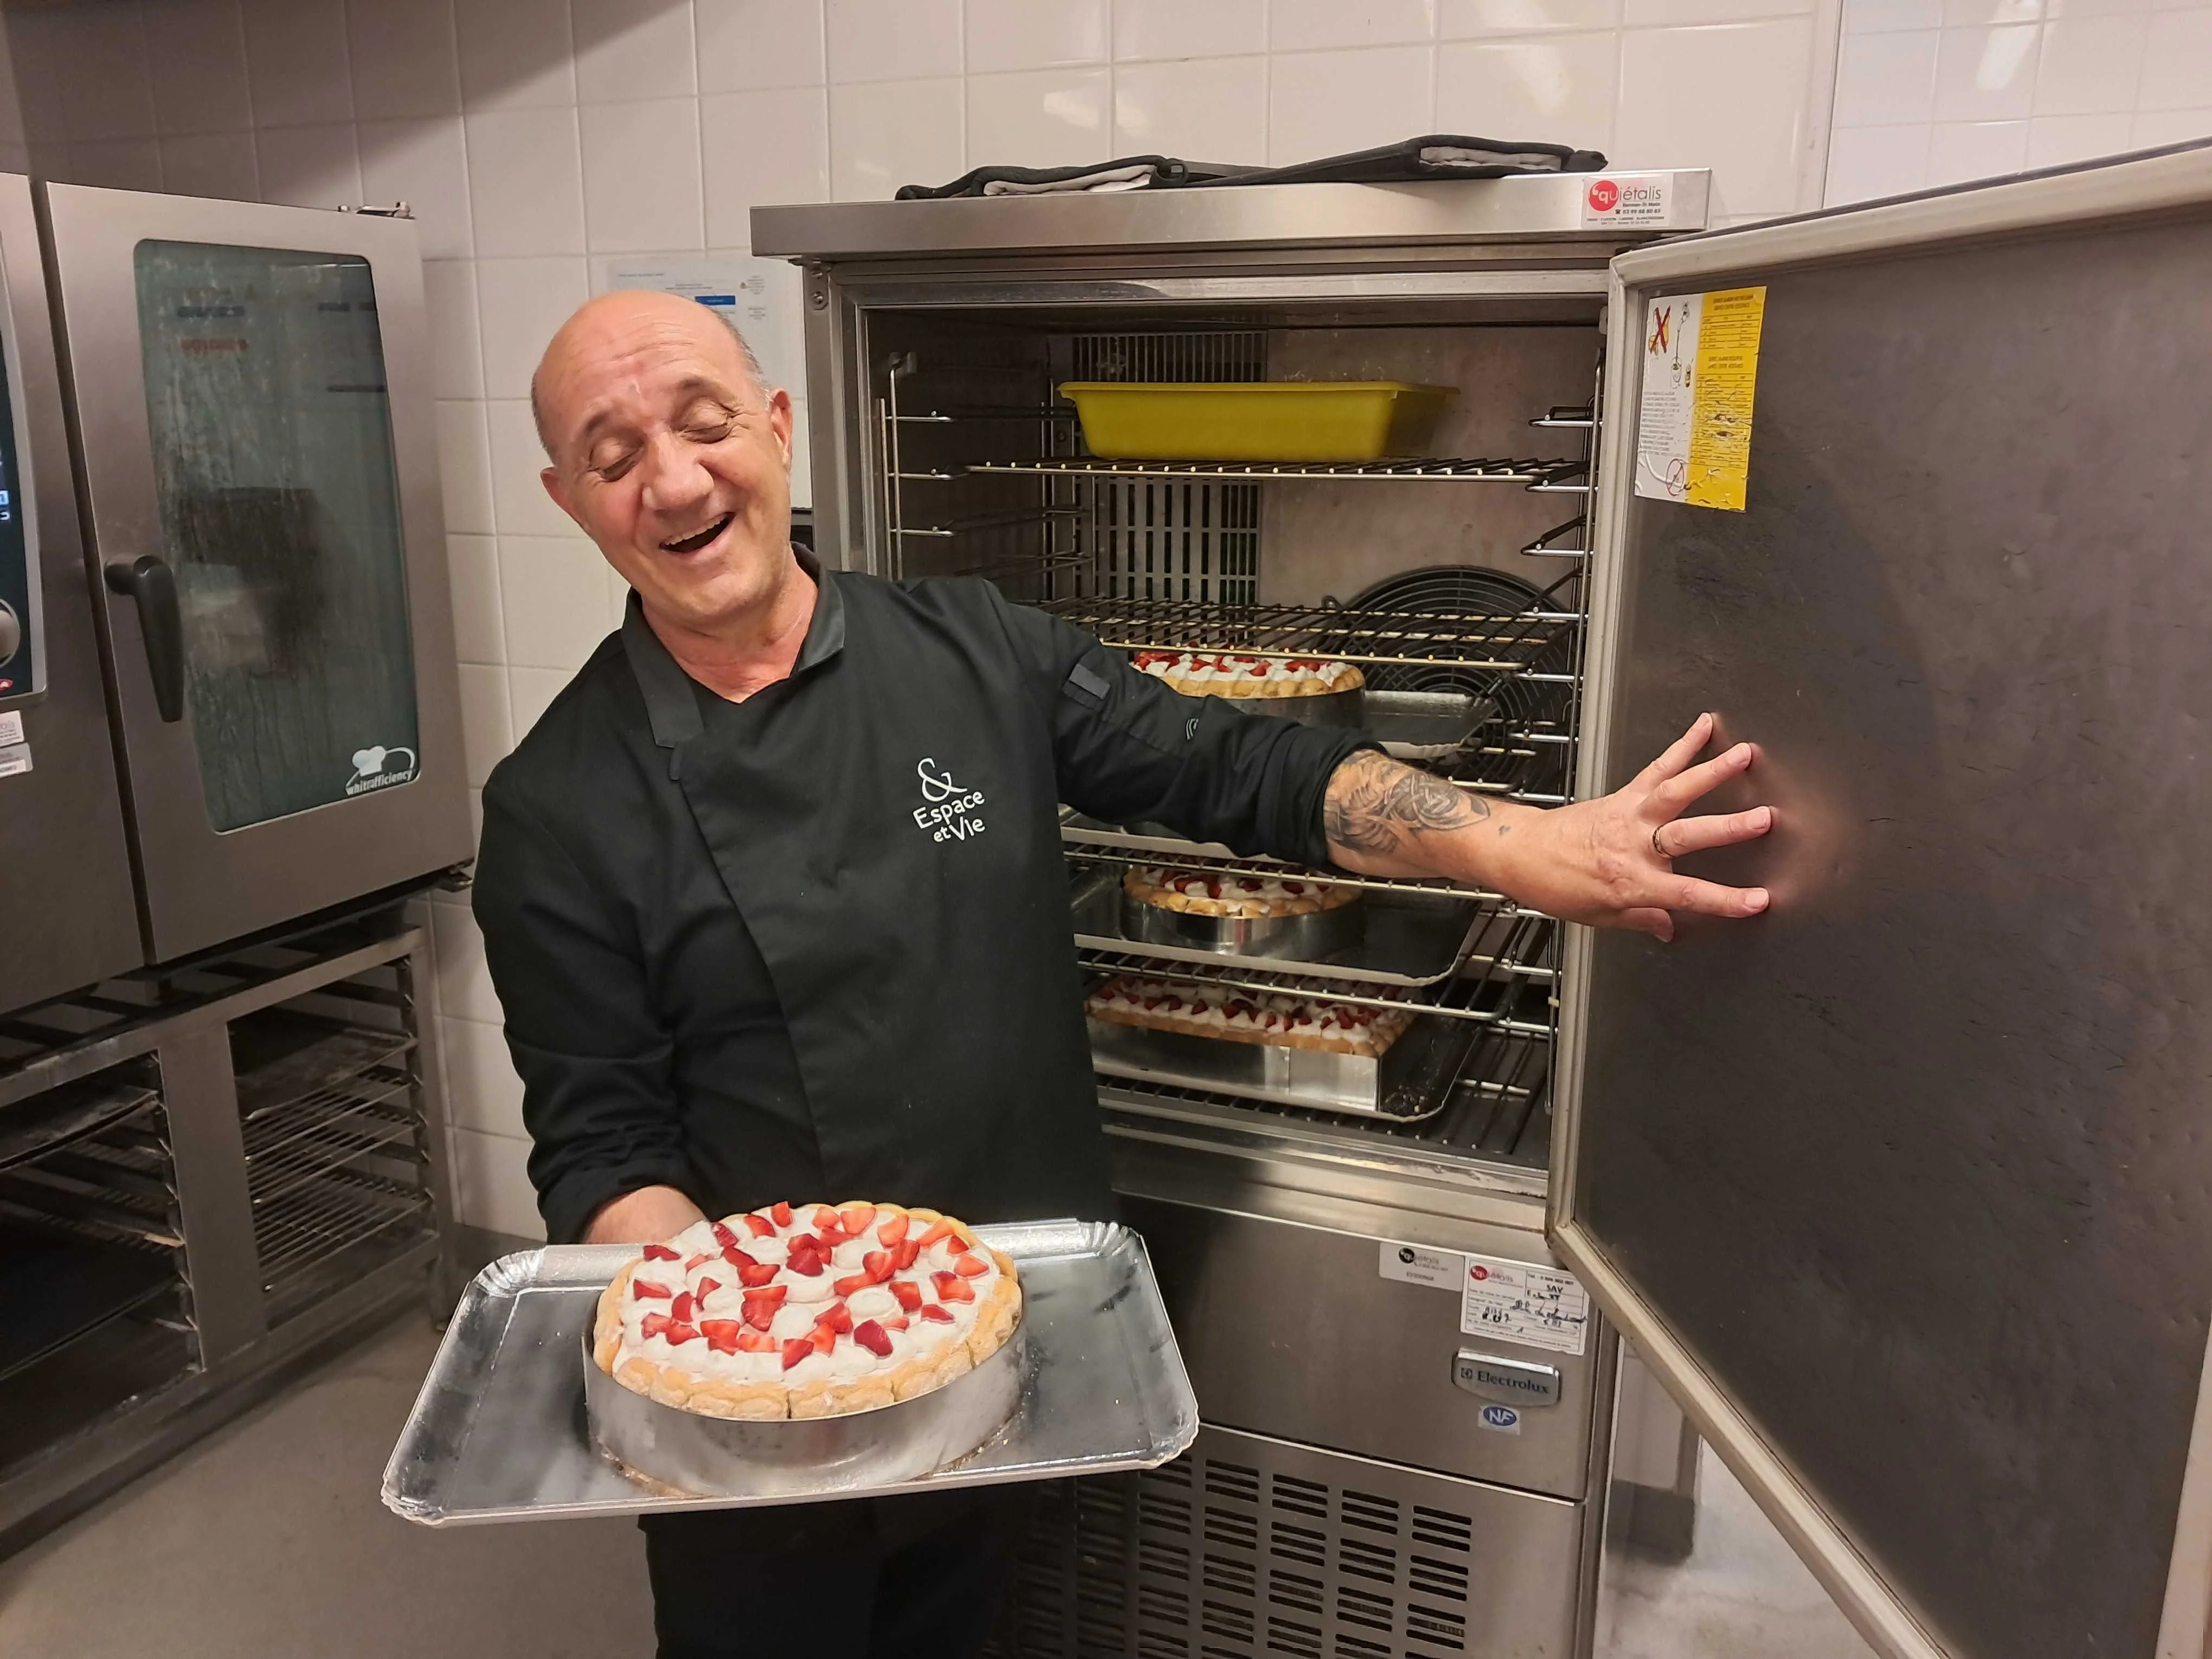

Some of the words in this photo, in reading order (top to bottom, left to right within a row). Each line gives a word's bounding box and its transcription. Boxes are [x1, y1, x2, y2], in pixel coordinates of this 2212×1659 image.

[912, 791, 985, 829] Espace
[933, 826, 951, 842] et
[948, 816, 986, 841] Vie
[1477, 1370, 1549, 1394] Electrolux
[1489, 1409, 1514, 1423] NF
